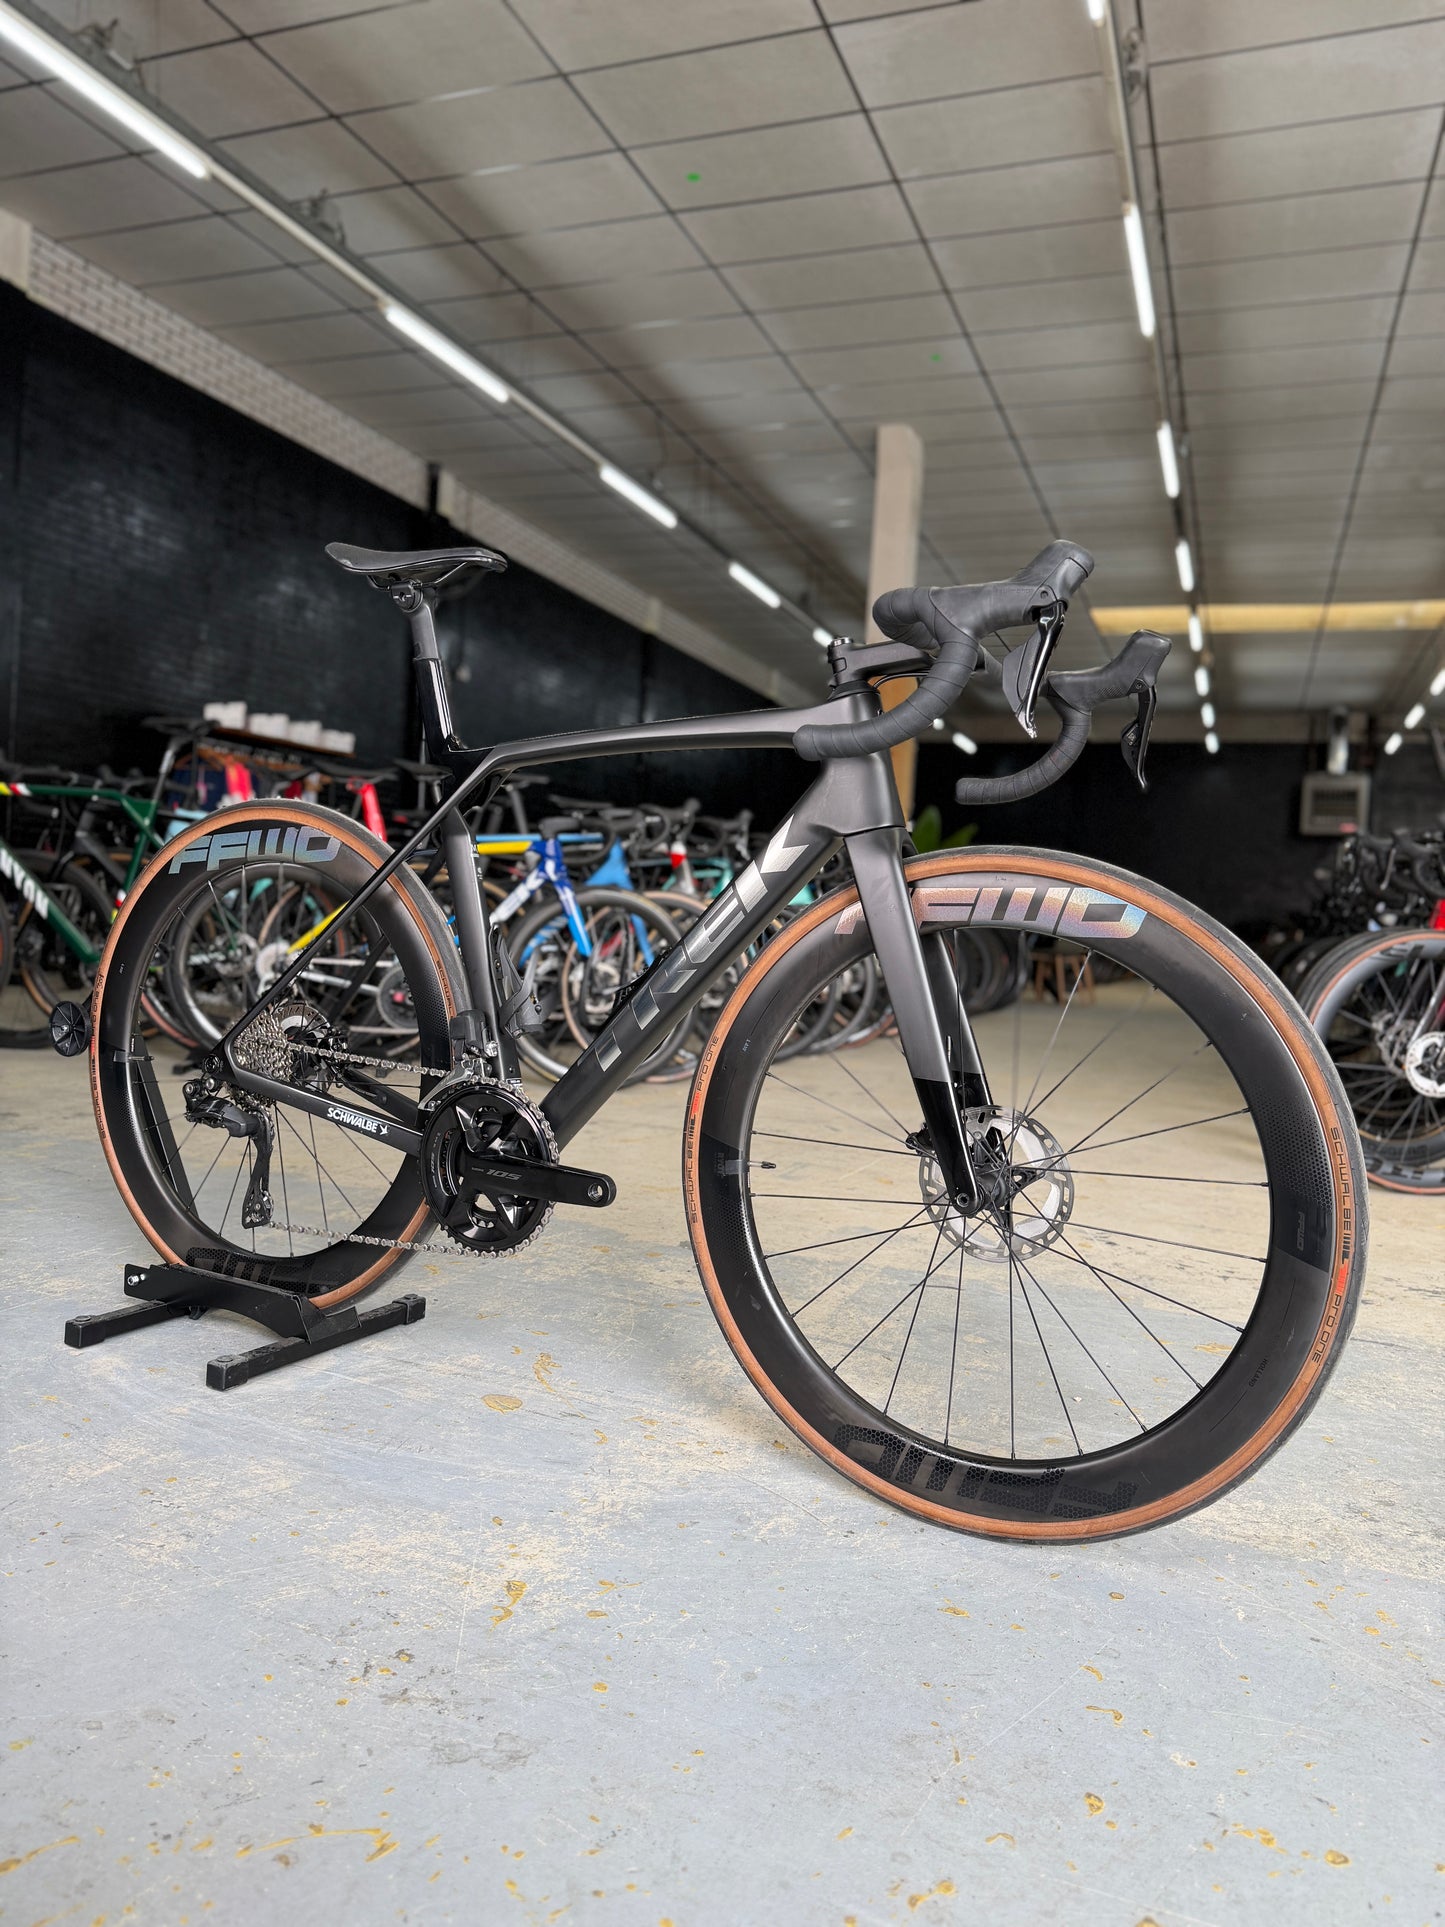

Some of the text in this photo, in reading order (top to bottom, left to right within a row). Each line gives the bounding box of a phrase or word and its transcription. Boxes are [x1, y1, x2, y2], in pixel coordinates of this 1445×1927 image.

[168, 826, 342, 875] FFWD
[577, 813, 810, 1072] TREK
[90, 1073, 107, 1140] SCHWALBE
[327, 1107, 379, 1133] SCHWALBE
[486, 1168, 523, 1181] 105
[685, 1140, 699, 1224] SCHWALBE
[1330, 1126, 1352, 1233] SCHWALBE
